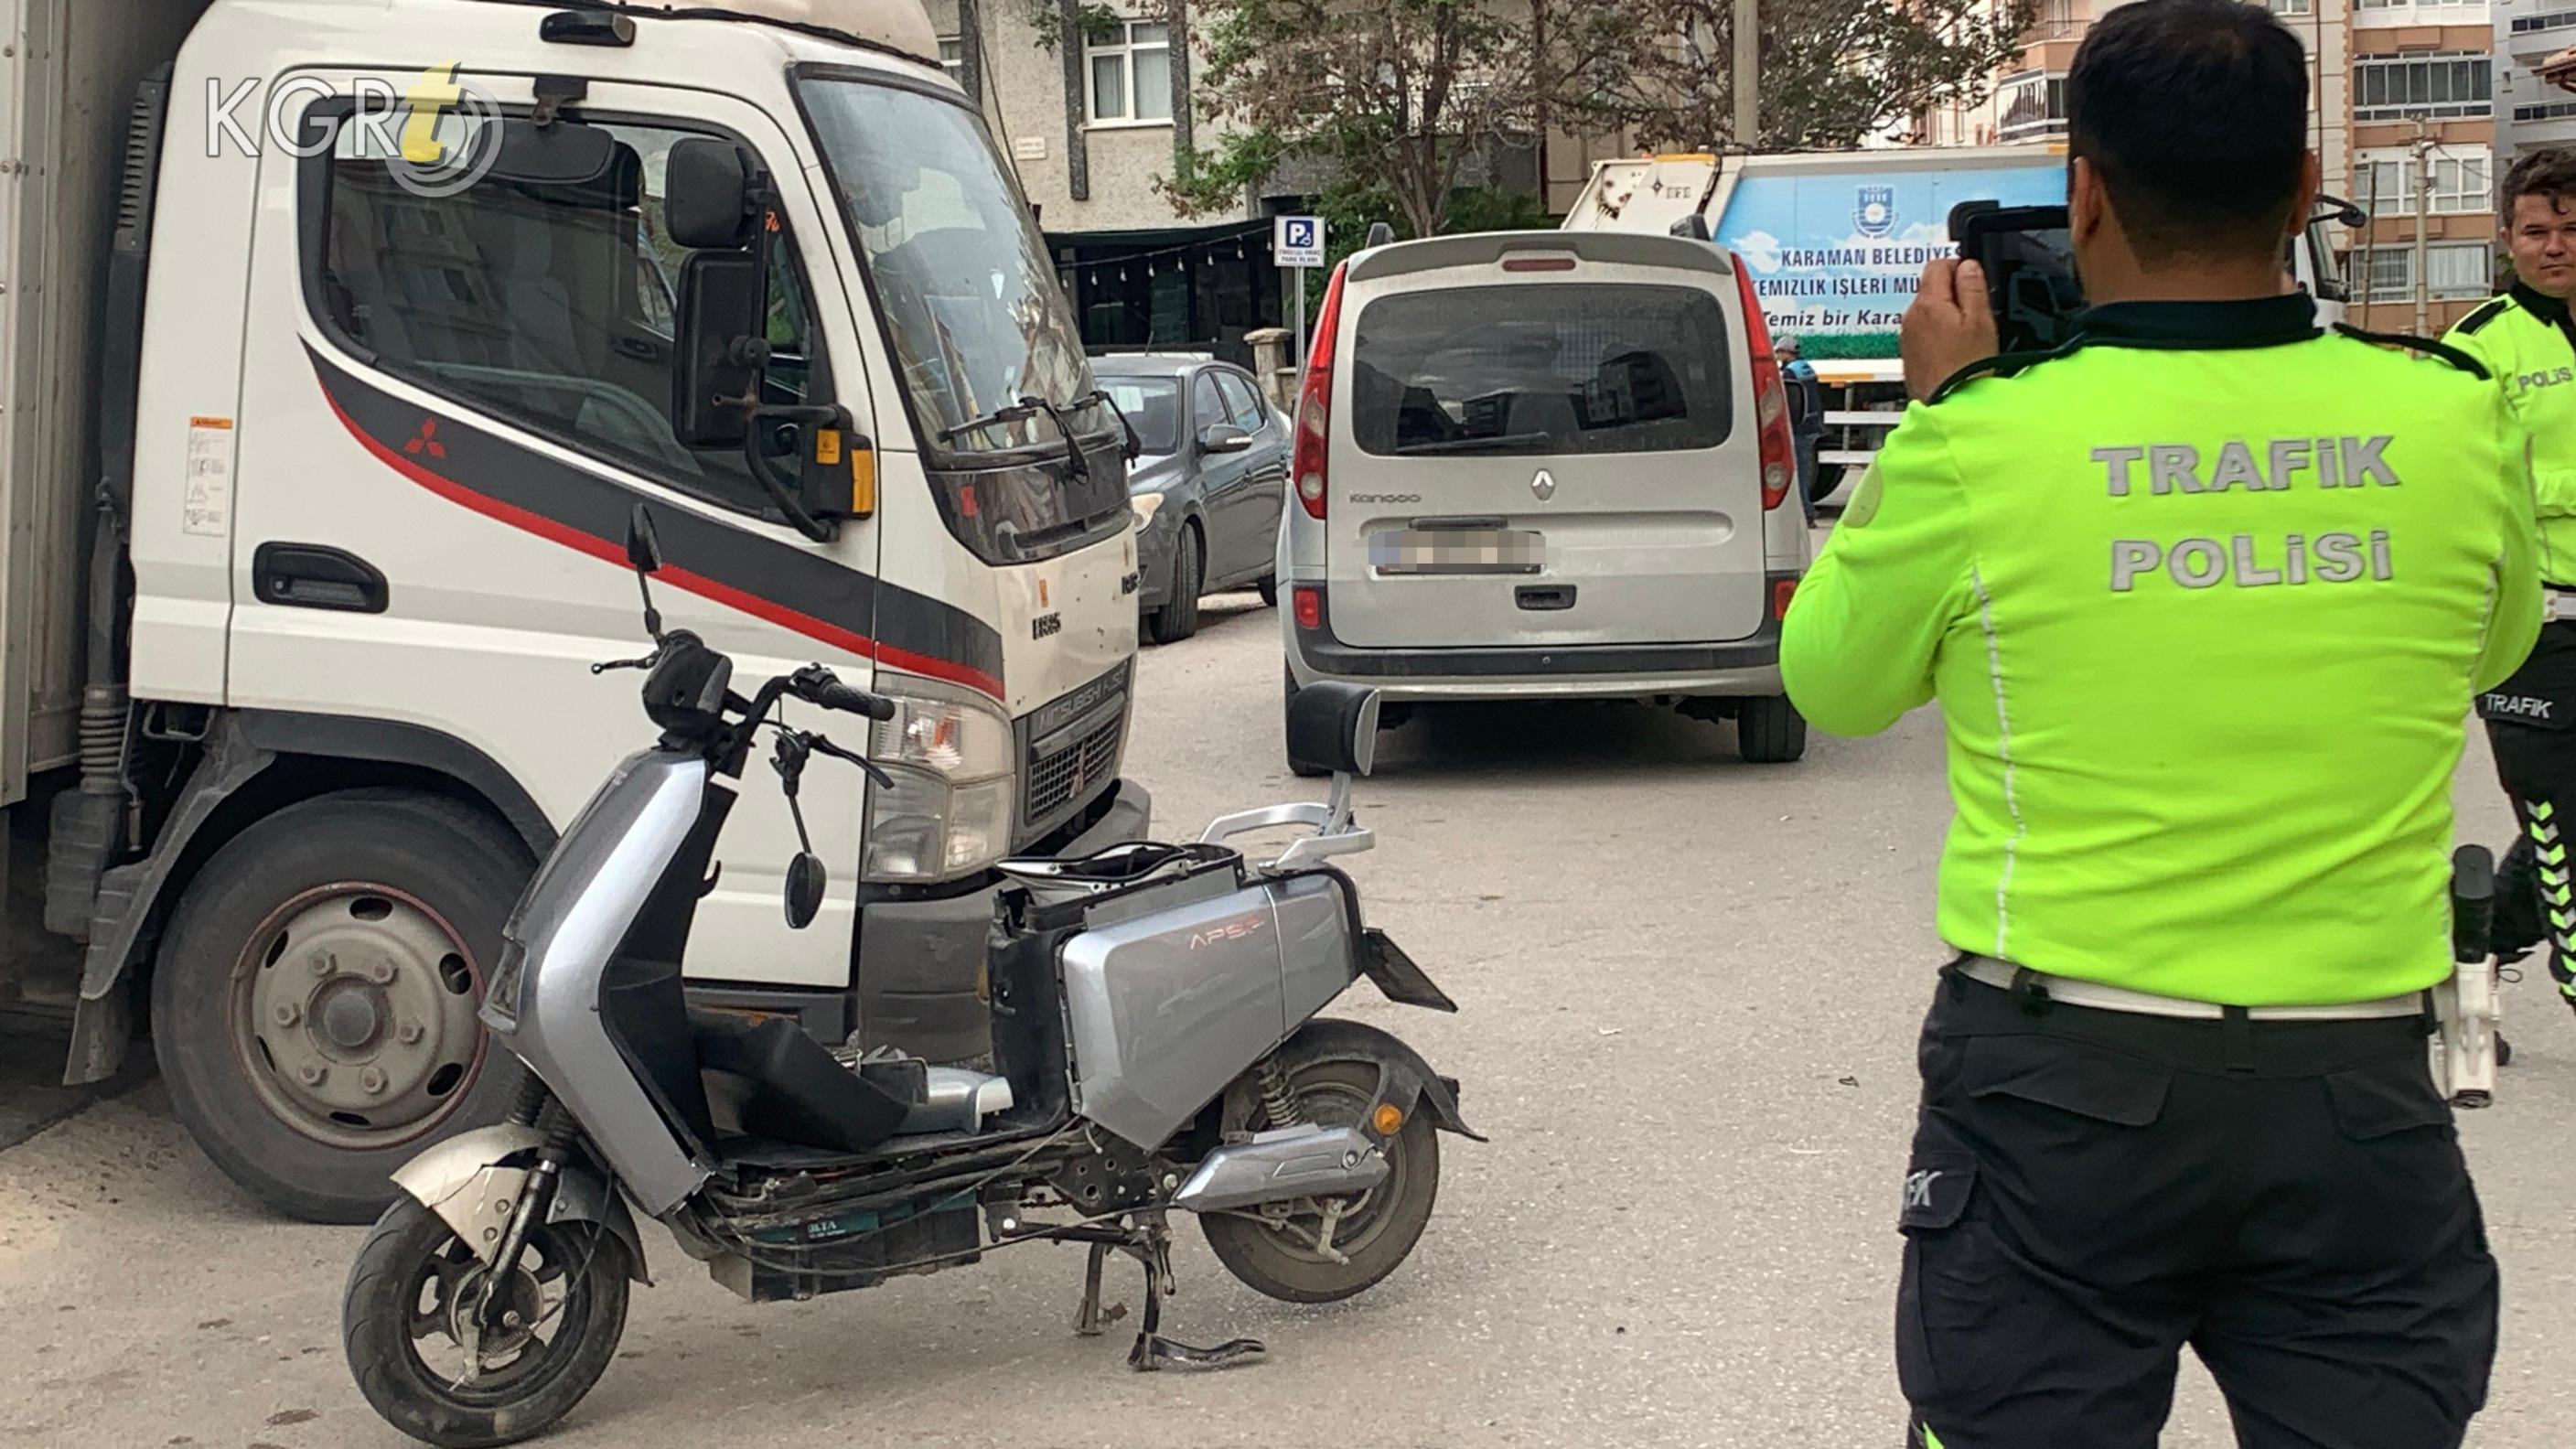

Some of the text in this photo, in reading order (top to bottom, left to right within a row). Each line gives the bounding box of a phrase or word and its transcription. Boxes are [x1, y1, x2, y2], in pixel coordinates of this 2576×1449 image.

[1781, 249, 1865, 266] KARAMAN
[1832, 274, 1886, 300] İŞLERİ
[1823, 309, 1850, 327] bir
